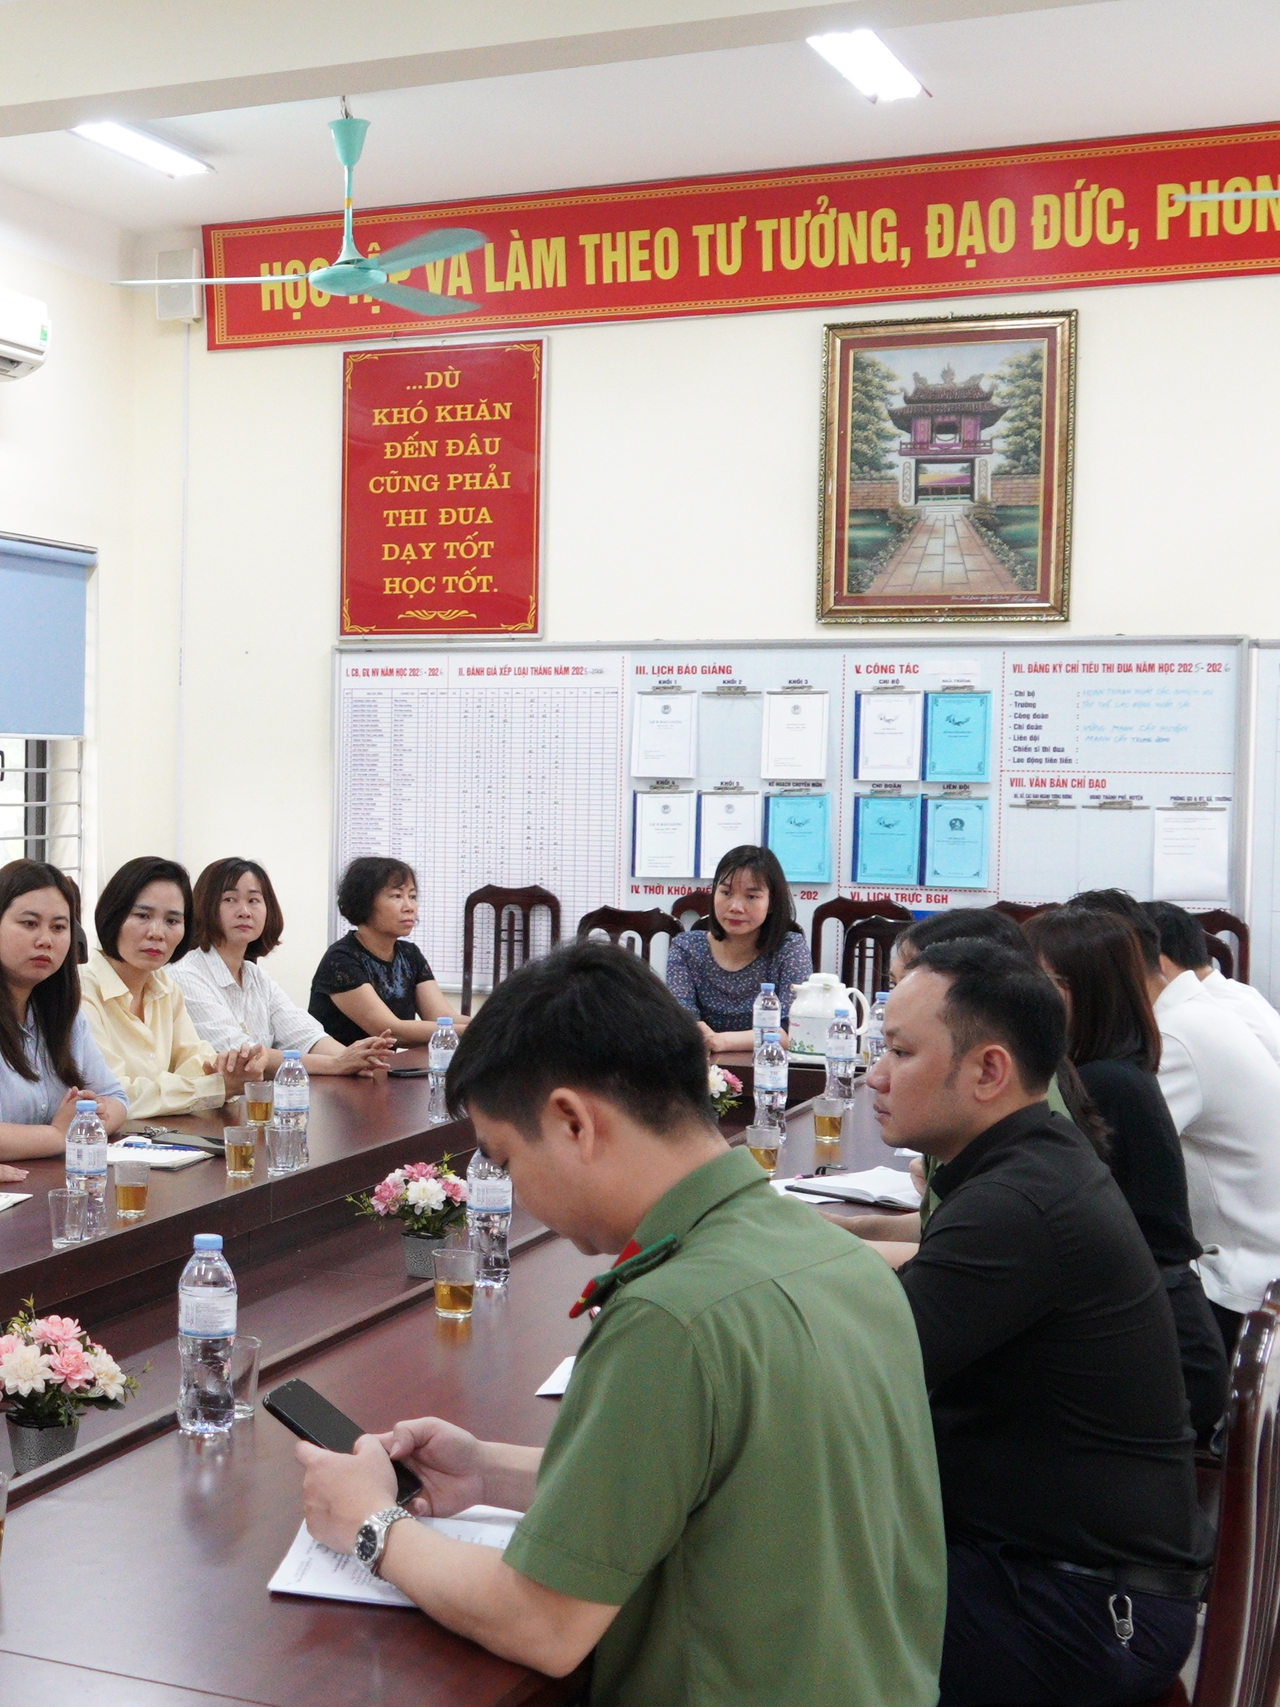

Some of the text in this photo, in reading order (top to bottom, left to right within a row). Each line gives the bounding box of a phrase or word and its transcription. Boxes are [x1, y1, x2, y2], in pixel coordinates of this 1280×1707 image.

[260, 257, 331, 320] HỌC
[484, 229, 568, 294] LÀM
[578, 227, 680, 286] THEO
[692, 215, 748, 276] TƯ
[755, 195, 912, 272] TƯỞNG,
[925, 197, 1016, 268] ĐẠO
[1030, 178, 1139, 250] ĐỨC,
[372, 399, 512, 426] KHÓ KHĂN
[384, 431, 501, 459] ĐẾN ĐÂU
[369, 464, 511, 493] CŨNG PHẢI
[383, 507, 493, 527] THI ĐUA
[382, 531, 494, 565] DẠY TỐT
[383, 566, 498, 598] HỌC TỐT.
[371, 668, 379, 677] NV
[381, 666, 394, 677] NĂM
[396, 668, 407, 678] HỌC
[486, 665, 497, 676] GIÁ
[499, 664, 512, 676] XẾP
[513, 667, 529, 678] LOẠI
[530, 665, 552, 676] THÁNG
[554, 665, 569, 676] NĂM
[635, 662, 732, 677] III. LỊCH BÁO GIẢNG
[866, 663, 895, 674] CÔNG
[900, 662, 919, 673] TÁC
[1013, 664, 1025, 673] VII.
[1028, 662, 1050, 673] ĐĂNG
[1052, 661, 1063, 673] KÝ
[1065, 660, 1079, 673] CHỈ
[1082, 661, 1099, 673] TIÊU
[1102, 663, 1114, 673] THI
[1117, 663, 1133, 673] ĐUA
[1136, 661, 1155, 673] NĂM
[1158, 663, 1175, 675] HỌC
[1010, 775, 1106, 791] VIII. VĂN BẢN CHỈ ĐẠO
[643, 883, 664, 894] THỜI
[667, 884, 693, 895] KHÓA
[850, 891, 863, 900] VI.
[894, 891, 922, 905] TRỰC
[926, 894, 948, 904] BGH
